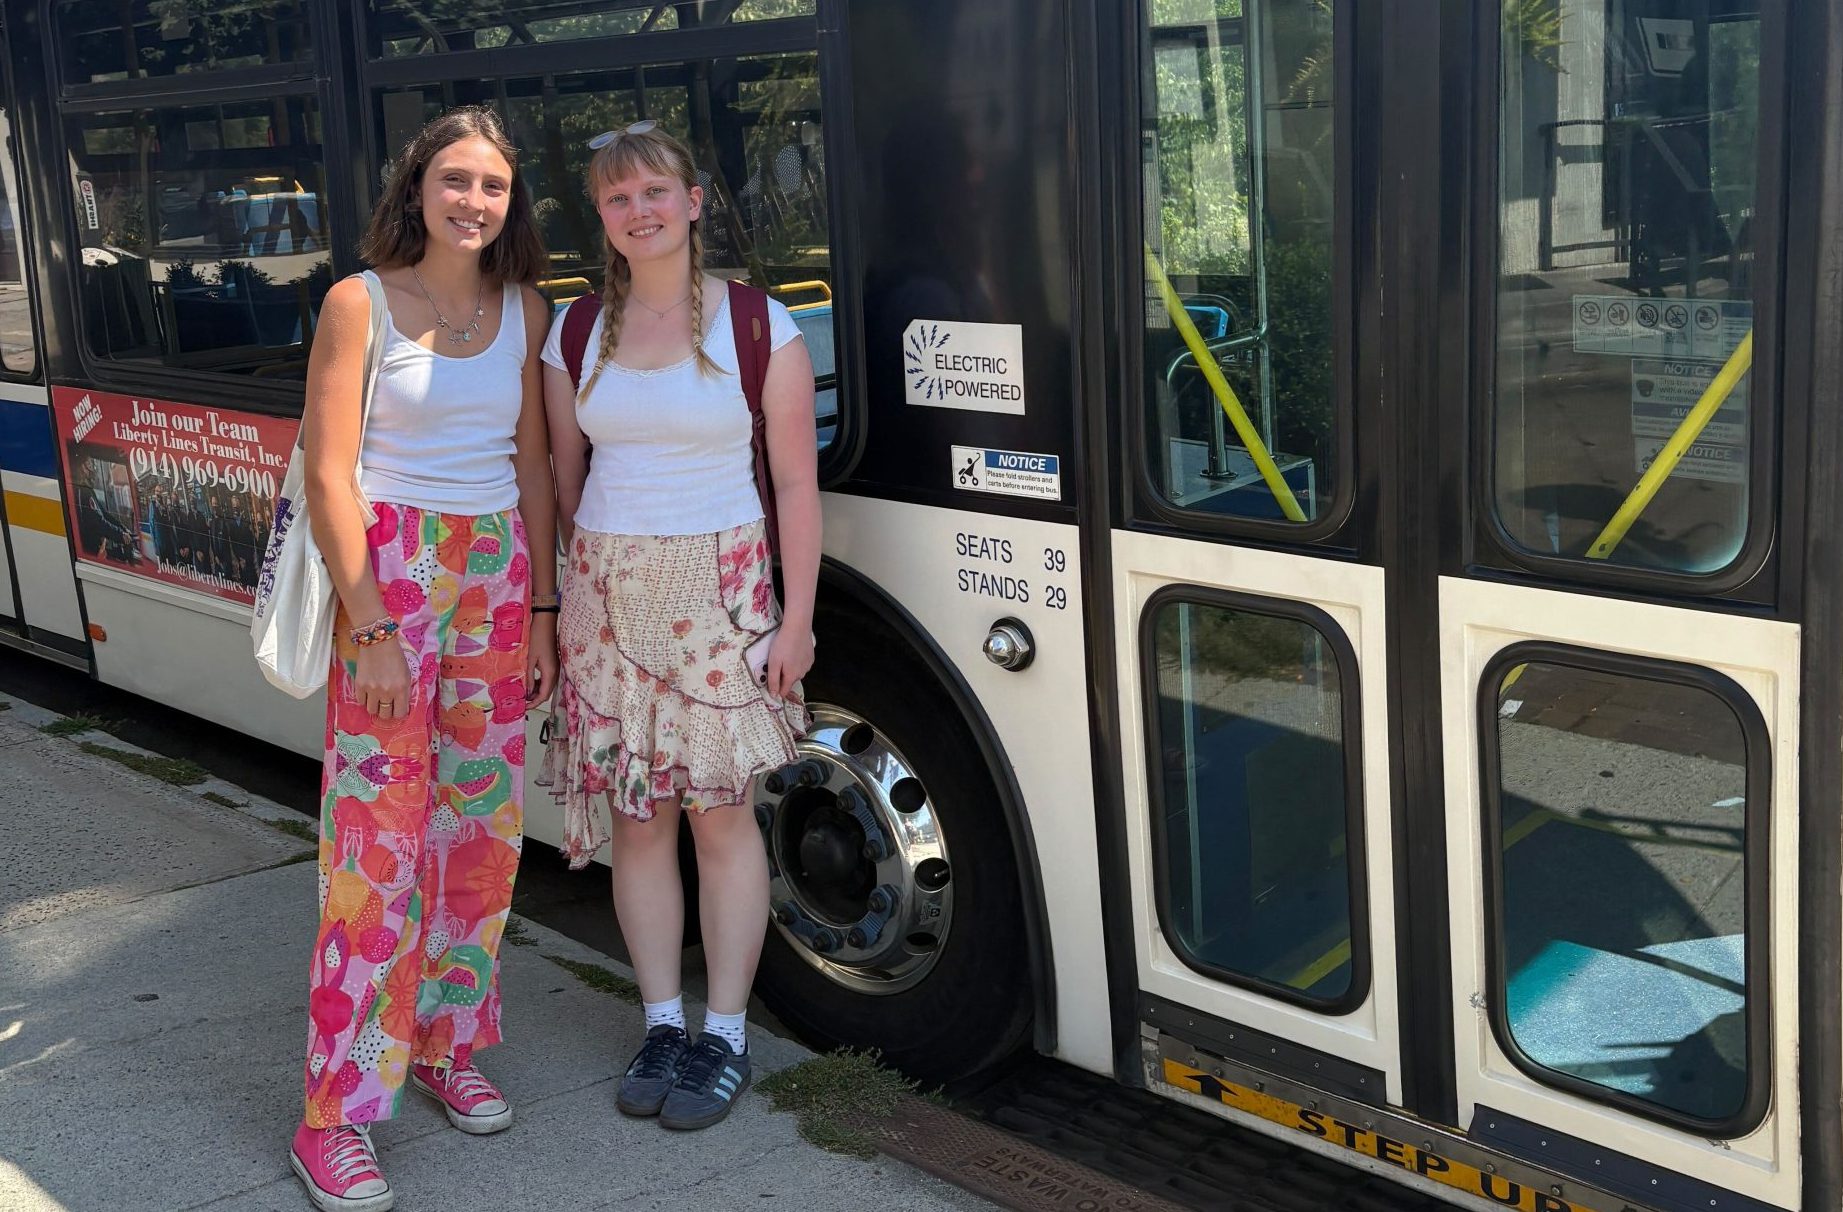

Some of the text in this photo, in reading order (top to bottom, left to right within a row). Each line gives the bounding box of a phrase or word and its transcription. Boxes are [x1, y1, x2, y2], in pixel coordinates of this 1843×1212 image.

[935, 353, 1007, 375] ELECTRIC
[1664, 364, 1713, 377] NOTICE
[72, 394, 92, 423] NOW
[945, 379, 1021, 401] POWERED
[72, 404, 103, 444] HIRING!
[131, 400, 259, 443] Join our Team
[113, 421, 288, 469] Liberty Lines Transit, Inc.
[998, 454, 1046, 471] NOTICE
[130, 447, 276, 499] (914) 969-6900
[987, 470, 1005, 478] Please
[1006, 472, 1017, 480] fold
[1017, 474, 1041, 483] strollers
[1002, 482, 1021, 490] before
[1021, 484, 1045, 494] entering
[956, 532, 1066, 573] SEATS 39
[157, 555, 257, 598] Jobs@libertylines.co
[958, 568, 1067, 610] STANDS 29
[973, 1155, 1070, 1201] WASTE
[996, 1147, 1109, 1199] WATERWAYS
[1296, 1107, 1572, 1212] STEP UP
